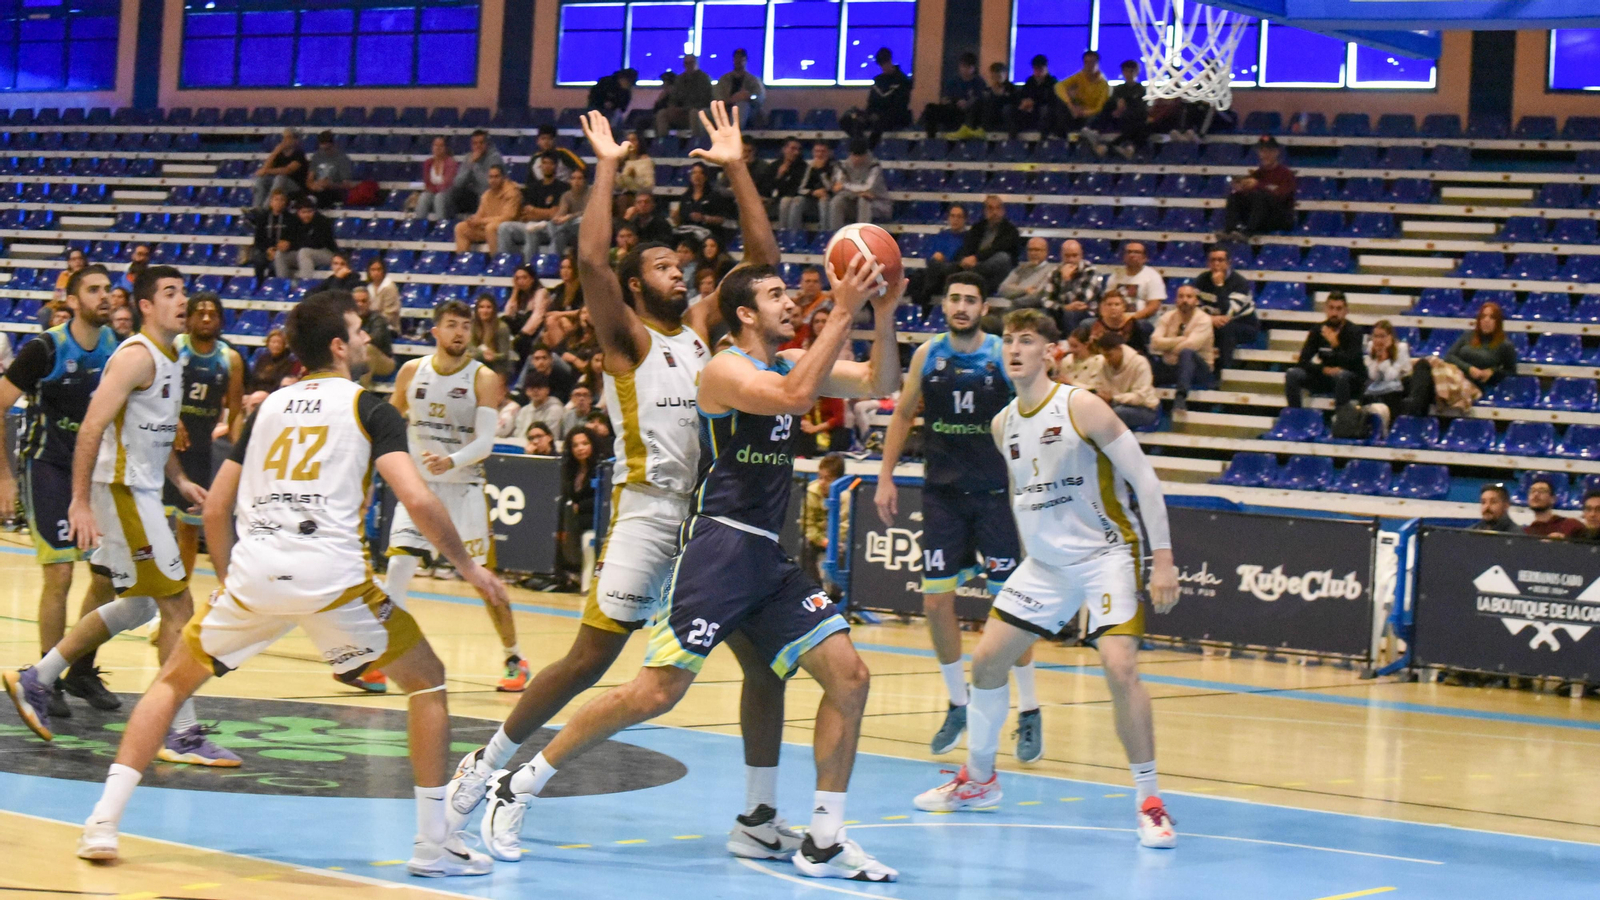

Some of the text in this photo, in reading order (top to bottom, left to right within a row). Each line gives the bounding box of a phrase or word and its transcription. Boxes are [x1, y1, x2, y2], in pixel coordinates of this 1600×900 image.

[189, 382, 208, 401] 21
[952, 390, 975, 413] 14
[283, 399, 322, 413] ATXA
[429, 402, 446, 418] 32
[770, 413, 793, 441] 29
[262, 425, 330, 481] 42
[57, 519, 70, 541] 2
[923, 548, 945, 571] 14
[1236, 563, 1363, 602] KubeClub
[1102, 593, 1111, 615] 9
[1477, 596, 1491, 611] LA
[1491, 597, 1550, 620] BOUTIQUE
[1550, 602, 1566, 618] DE
[1567, 605, 1581, 620] LA
[687, 618, 720, 648] 29
